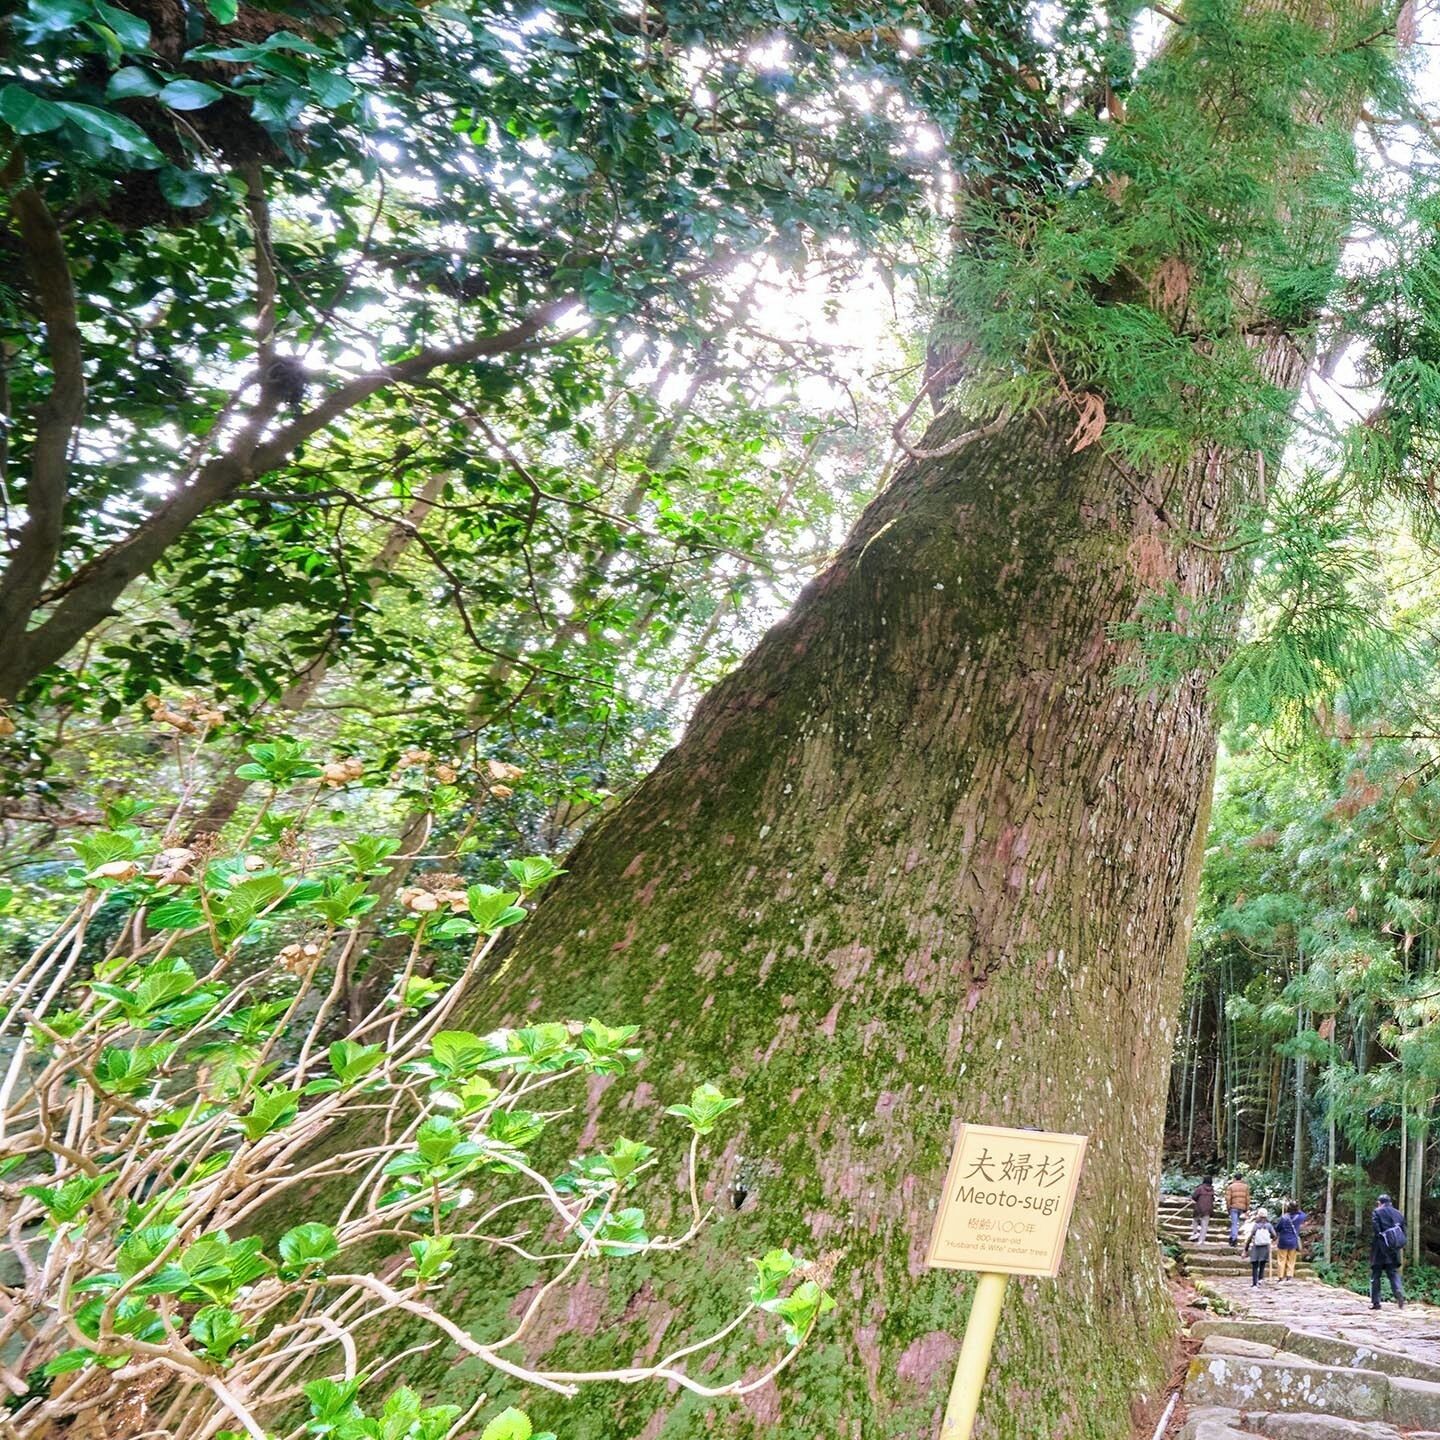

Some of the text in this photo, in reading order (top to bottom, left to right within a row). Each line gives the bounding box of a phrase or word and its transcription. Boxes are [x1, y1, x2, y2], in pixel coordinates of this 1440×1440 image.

[963, 1148, 1066, 1188] 夫婦杉
[955, 1185, 1061, 1216] Meoto-sugi
[1007, 1246, 1029, 1255] cedar
